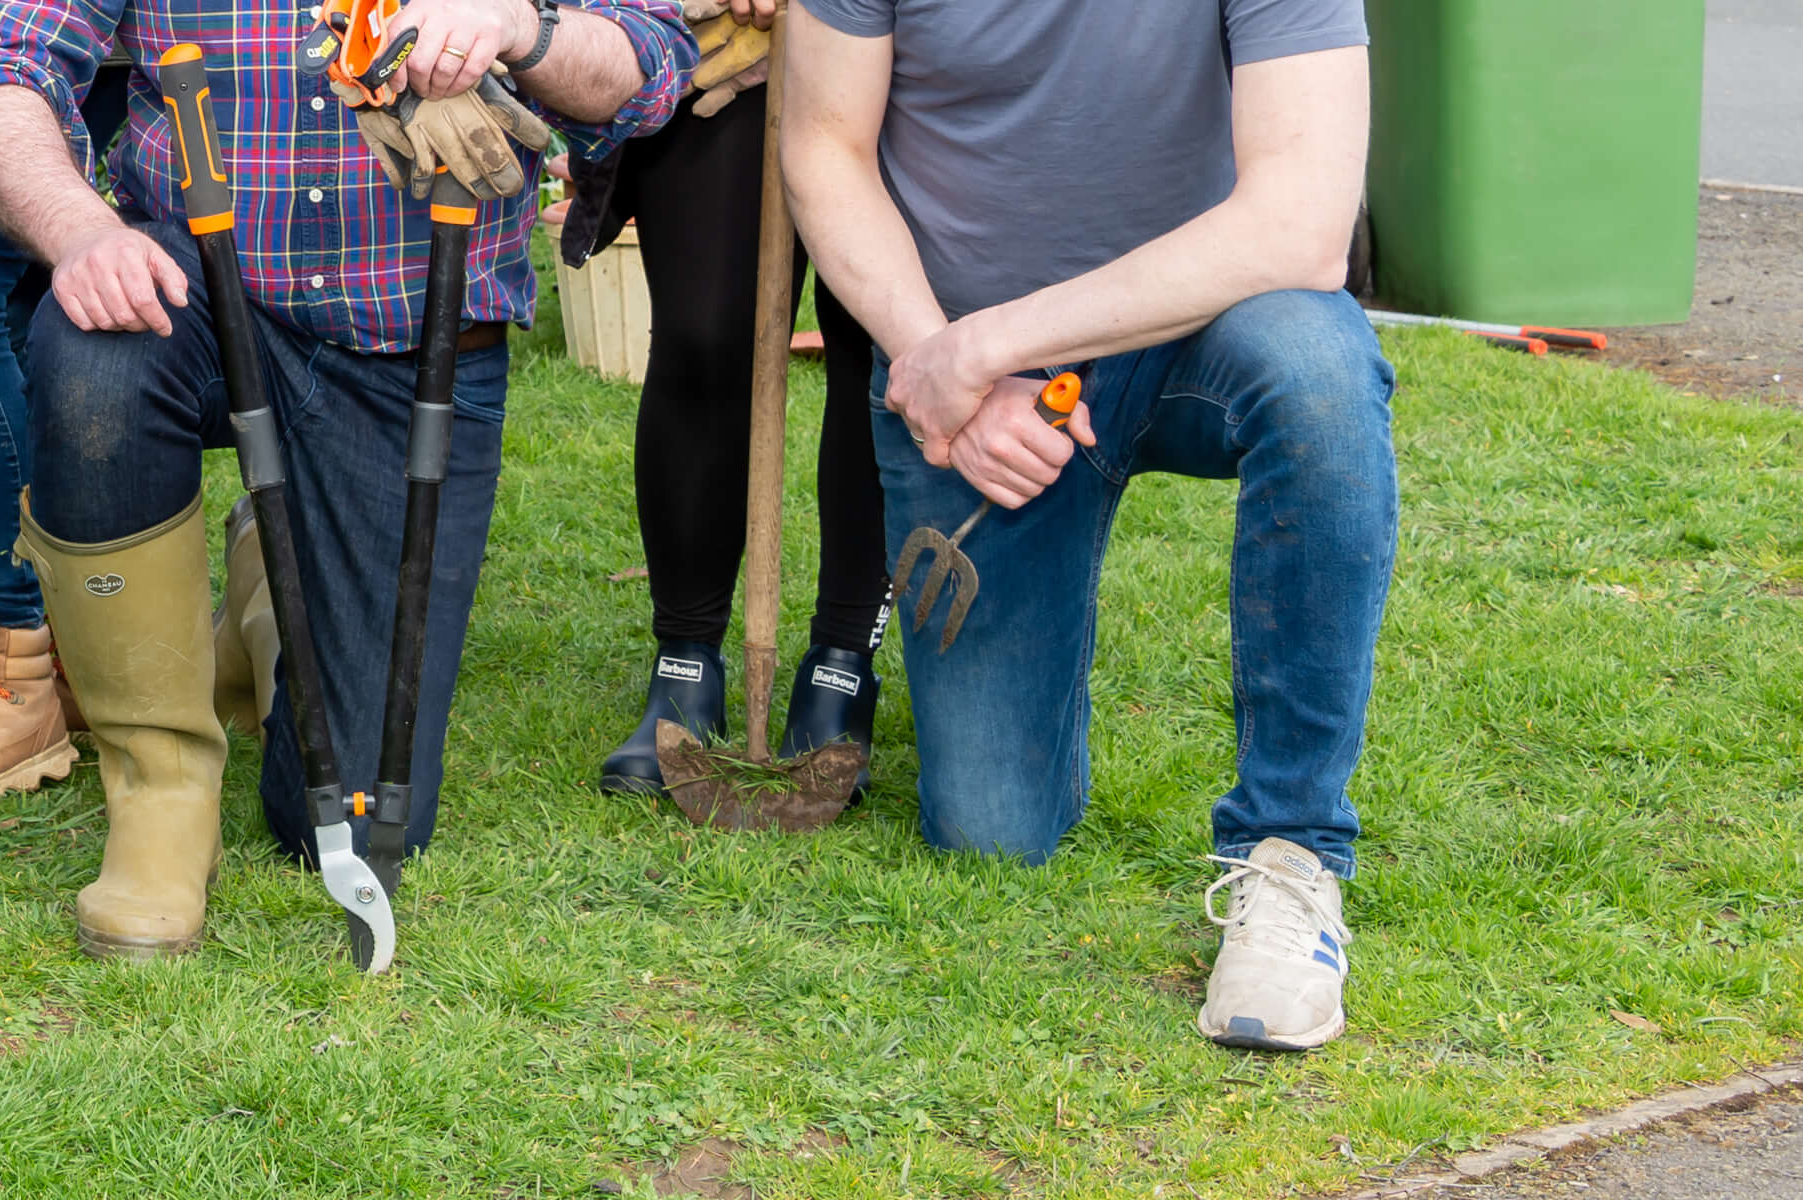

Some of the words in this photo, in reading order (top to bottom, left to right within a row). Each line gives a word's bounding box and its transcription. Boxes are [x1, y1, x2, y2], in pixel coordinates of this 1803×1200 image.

[868, 604, 891, 649] THE
[815, 670, 856, 691] Barbour
[1284, 854, 1314, 877] adidas
